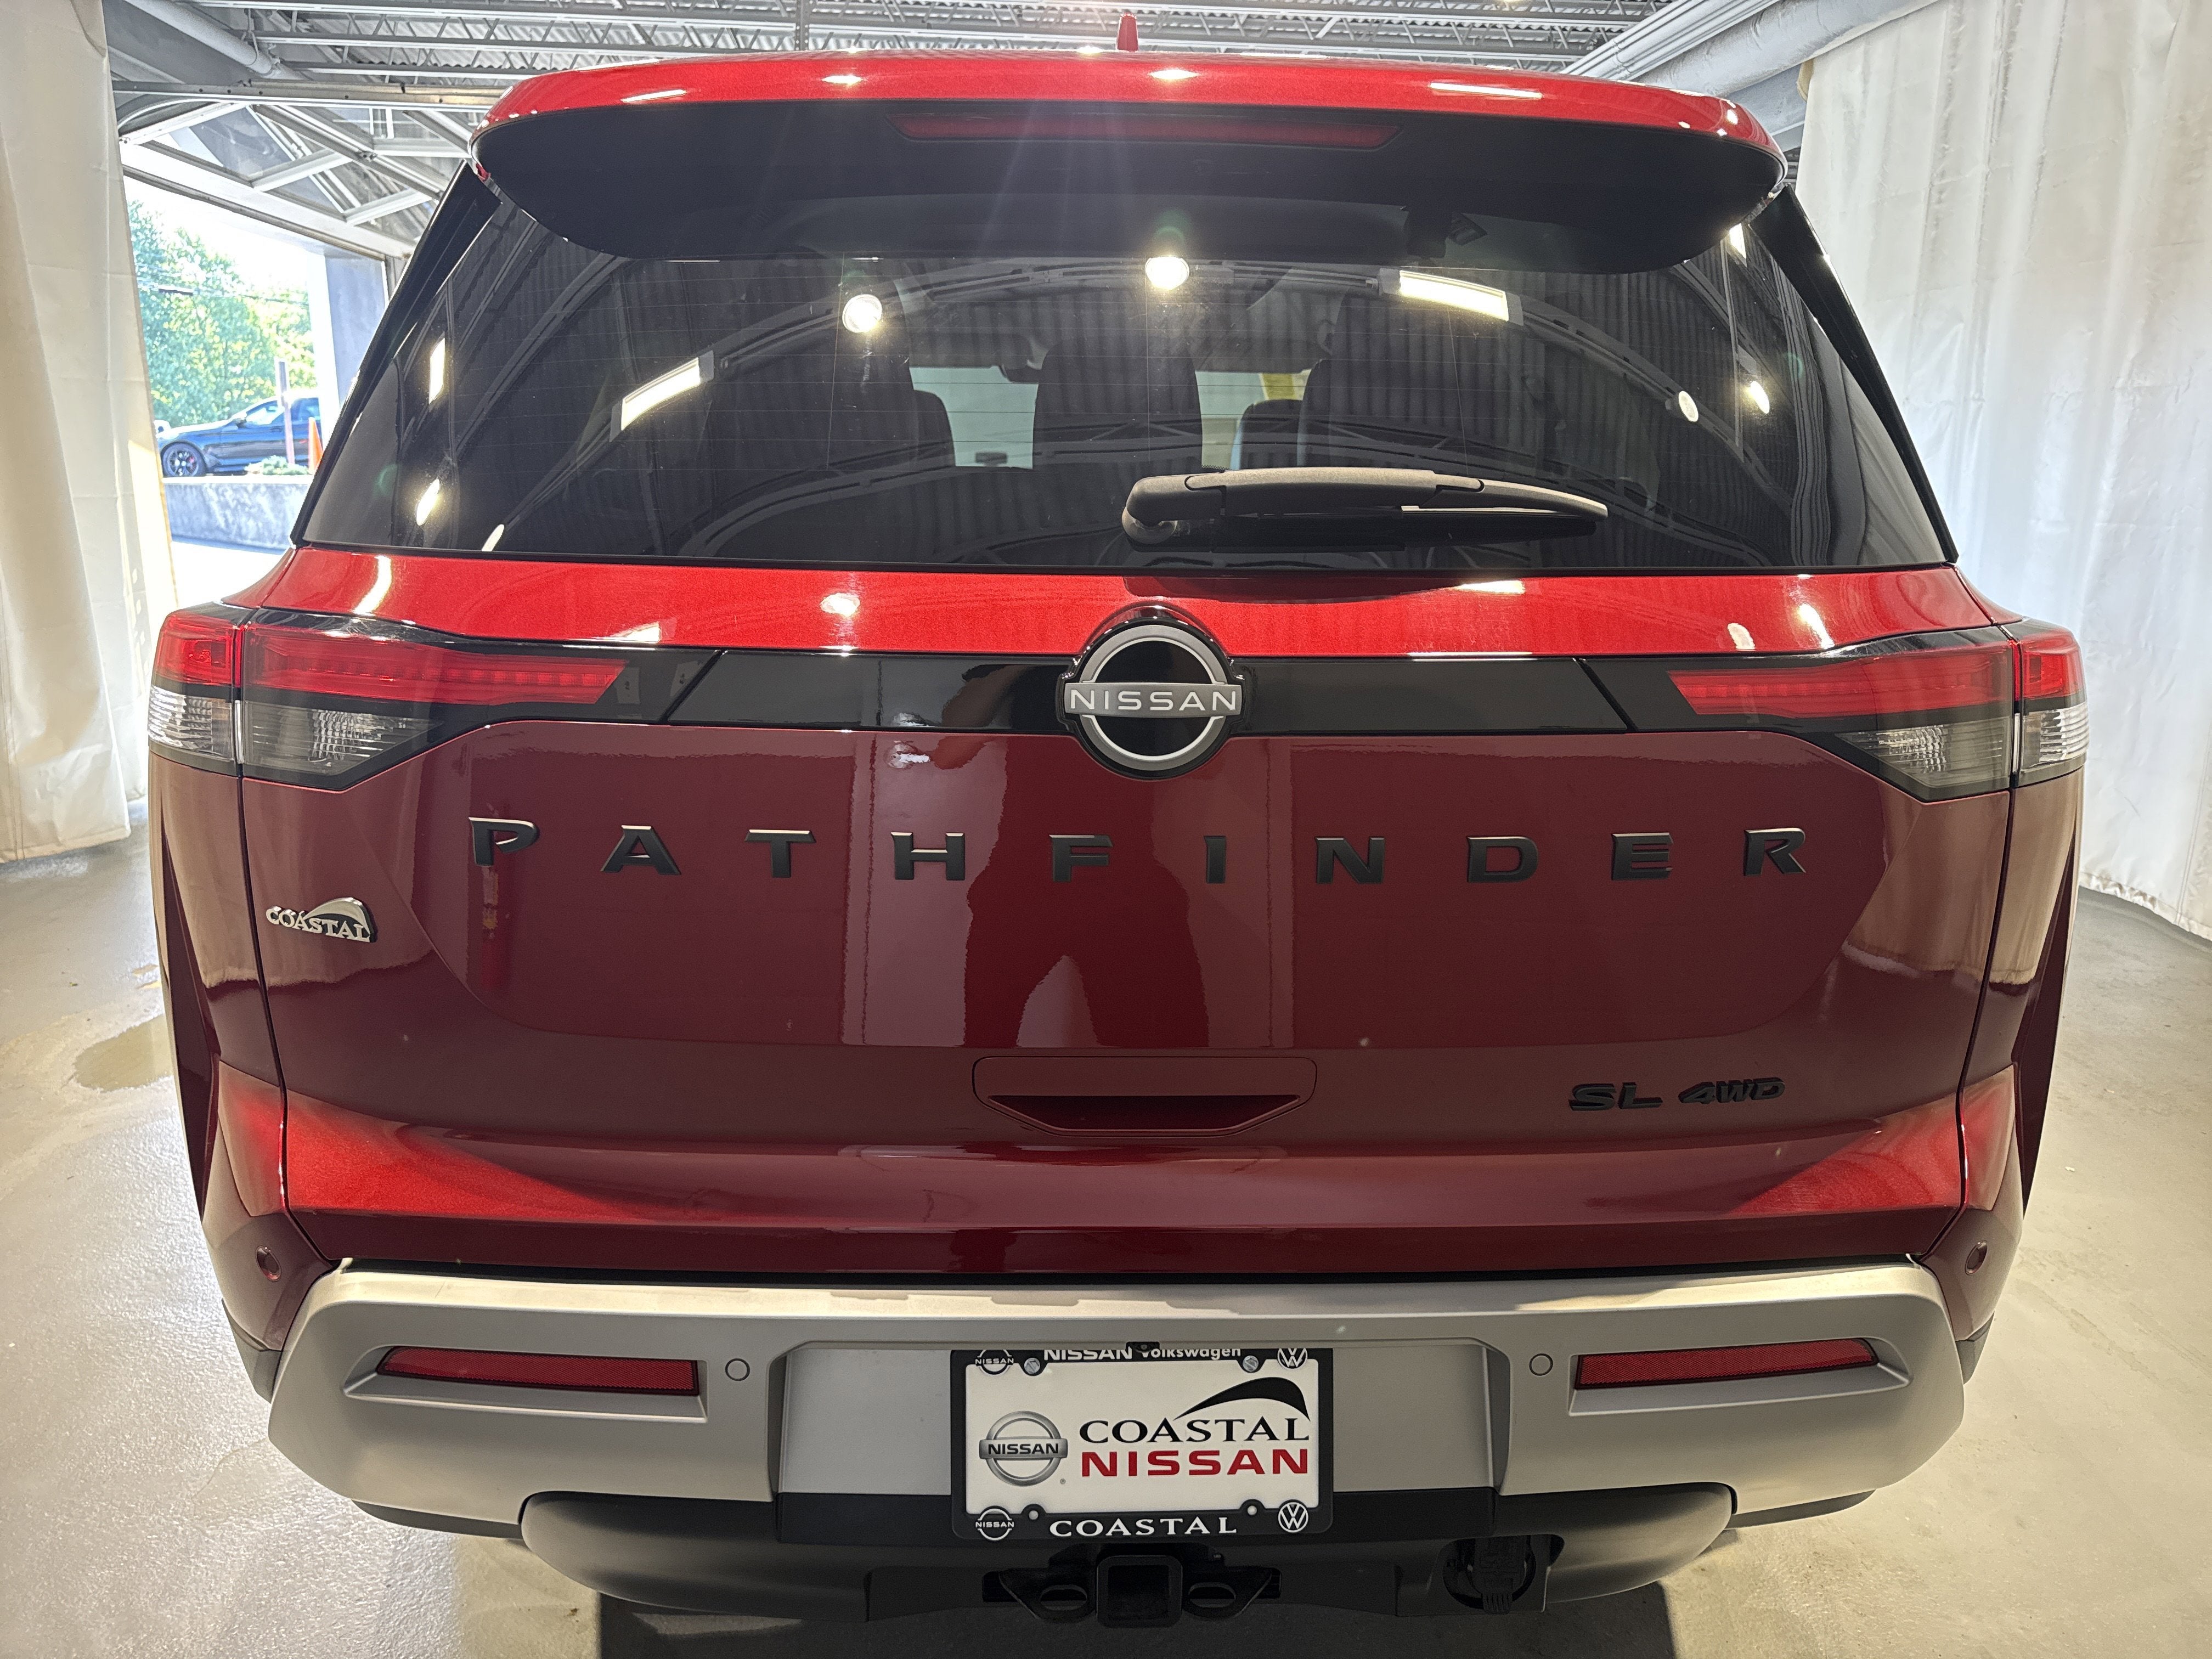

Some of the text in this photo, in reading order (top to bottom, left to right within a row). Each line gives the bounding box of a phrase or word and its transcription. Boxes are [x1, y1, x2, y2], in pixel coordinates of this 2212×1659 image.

[1070, 689, 1236, 711] NISSAN
[468, 817, 1806, 884] PATHFINDER
[266, 906, 371, 943] COASTAL
[1568, 1077, 1786, 1111] SL 4WD
[1044, 1346, 1132, 1361] NISSAN
[1079, 1415, 1310, 1443] COASTAL
[988, 1443, 1059, 1454] NISSAN
[1082, 1448, 1308, 1477] NISSAN
[1049, 1516, 1237, 1537] COASTAL
